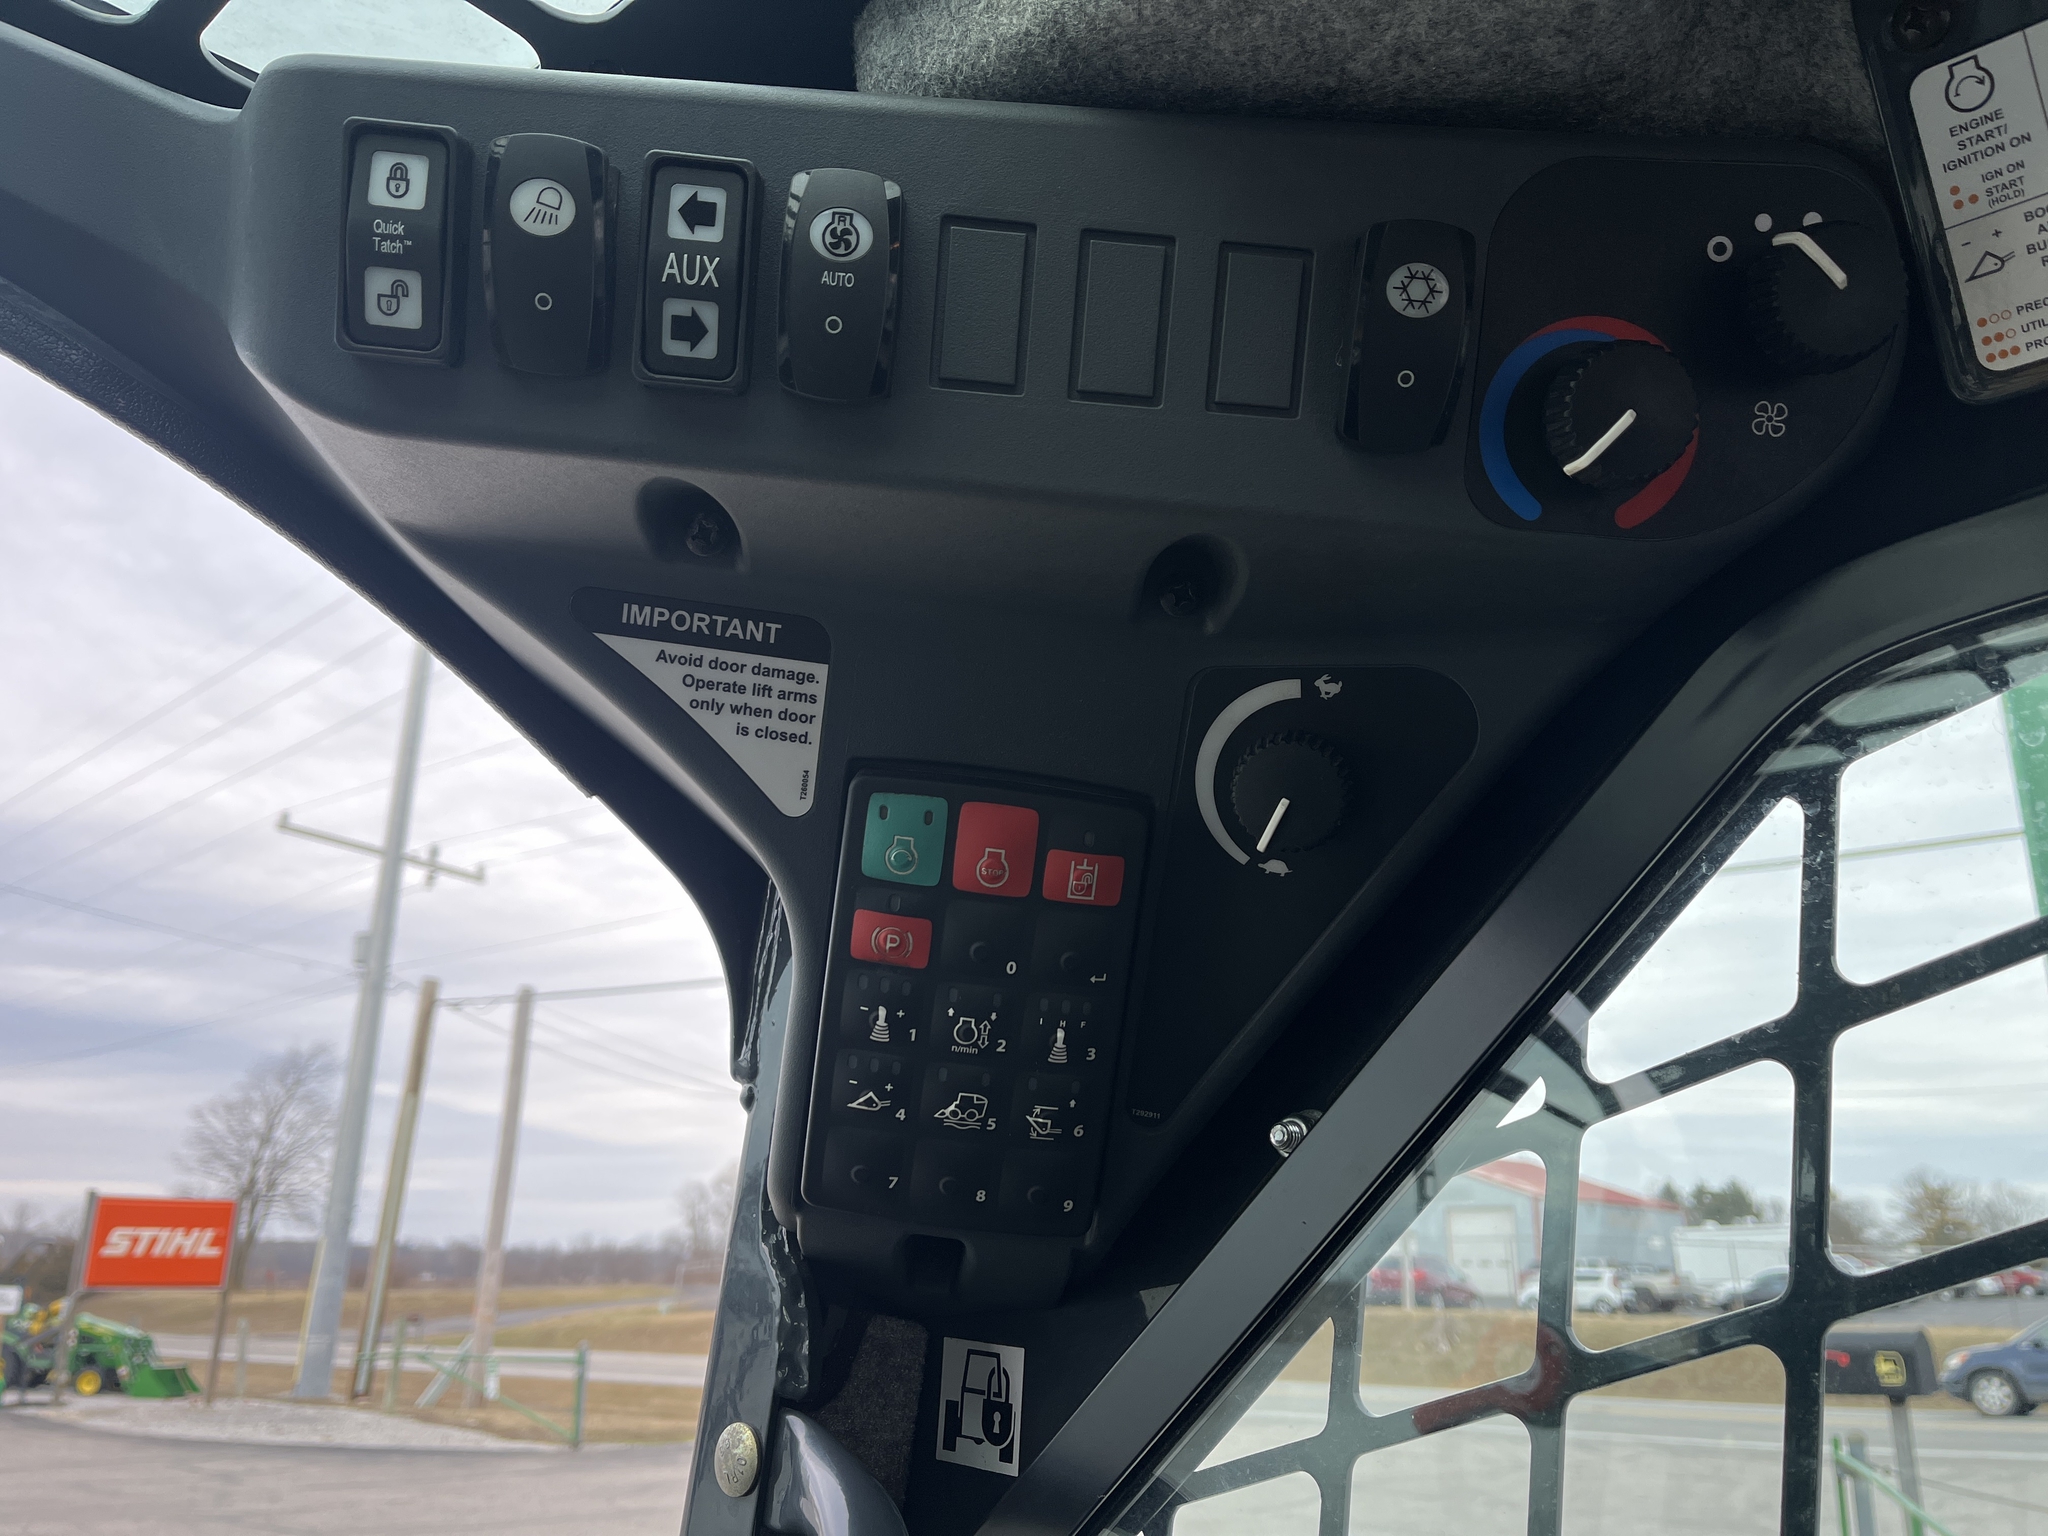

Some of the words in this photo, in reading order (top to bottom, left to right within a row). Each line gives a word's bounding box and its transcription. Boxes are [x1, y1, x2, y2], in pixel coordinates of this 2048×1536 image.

[1948, 108, 2006, 139] ENGINE
[1956, 122, 2009, 152] START/
[1942, 139, 2006, 174] IGNITION
[2007, 131, 2032, 153] ON
[1981, 165, 2004, 184] IGN
[2006, 159, 2026, 176] ON
[1985, 175, 2026, 198] START
[1987, 187, 2026, 210] (HOLD)
[373, 219, 404, 237] Quick
[2025, 238, 2048, 255] BU
[661, 253, 720, 288] AUX
[821, 271, 855, 288] AUTO
[621, 602, 782, 644] IMPORTANT
[655, 649, 704, 669] Avoid
[708, 656, 747, 675] door
[751, 662, 820, 686] damage.
[682, 673, 747, 696] Operate
[751, 683, 773, 700] lift
[777, 689, 818, 705] arms
[689, 695, 725, 716] only
[729, 703, 773, 720] when
[777, 708, 817, 725] door
[735, 722, 750, 737] is
[754, 724, 812, 746] closed.
[981, 867, 1004, 877] STOP
[884, 933, 901, 950] P
[1005, 960, 1018, 976] 0
[1059, 1019, 1067, 1028] H
[1080, 1020, 1087, 1029] F
[908, 1028, 918, 1042] 1
[951, 1045, 979, 1055] n/min
[995, 1039, 1007, 1053] 2
[1085, 1047, 1097, 1061] 3
[894, 1108, 906, 1122] 4
[986, 1118, 998, 1131] 5
[1073, 1124, 1085, 1138] 6
[887, 1176, 899, 1189] 7
[975, 1189, 987, 1203] 8
[1062, 1199, 1074, 1213] 9
[98, 1226, 223, 1259] STIHL
